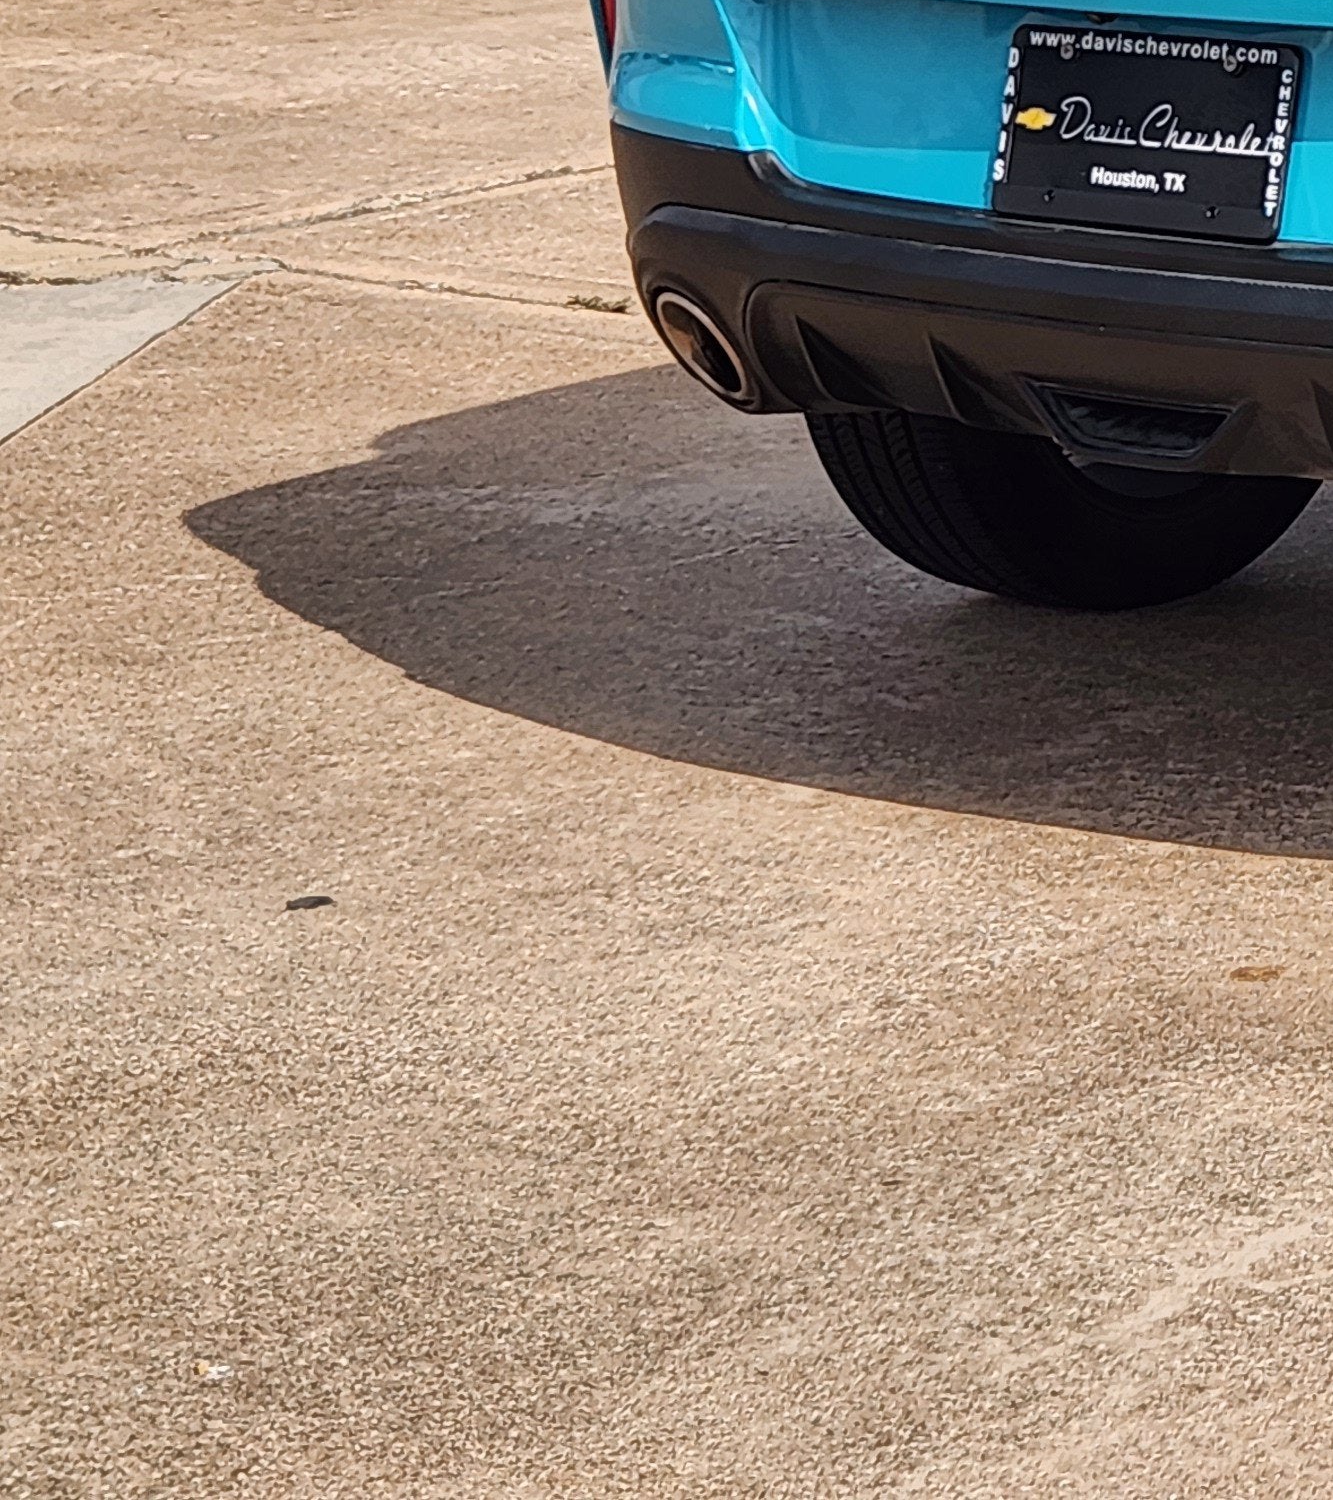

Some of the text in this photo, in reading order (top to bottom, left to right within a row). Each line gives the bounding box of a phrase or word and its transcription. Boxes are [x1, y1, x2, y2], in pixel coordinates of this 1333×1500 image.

[1029, 29, 1279, 66] www.davischevroletcom
[992, 46, 1020, 182] DAVIS
[1059, 95, 1276, 157] Davis Chevrolet
[1264, 69, 1294, 218] CHEVROLET
[1090, 166, 1187, 194] Houston, TX
